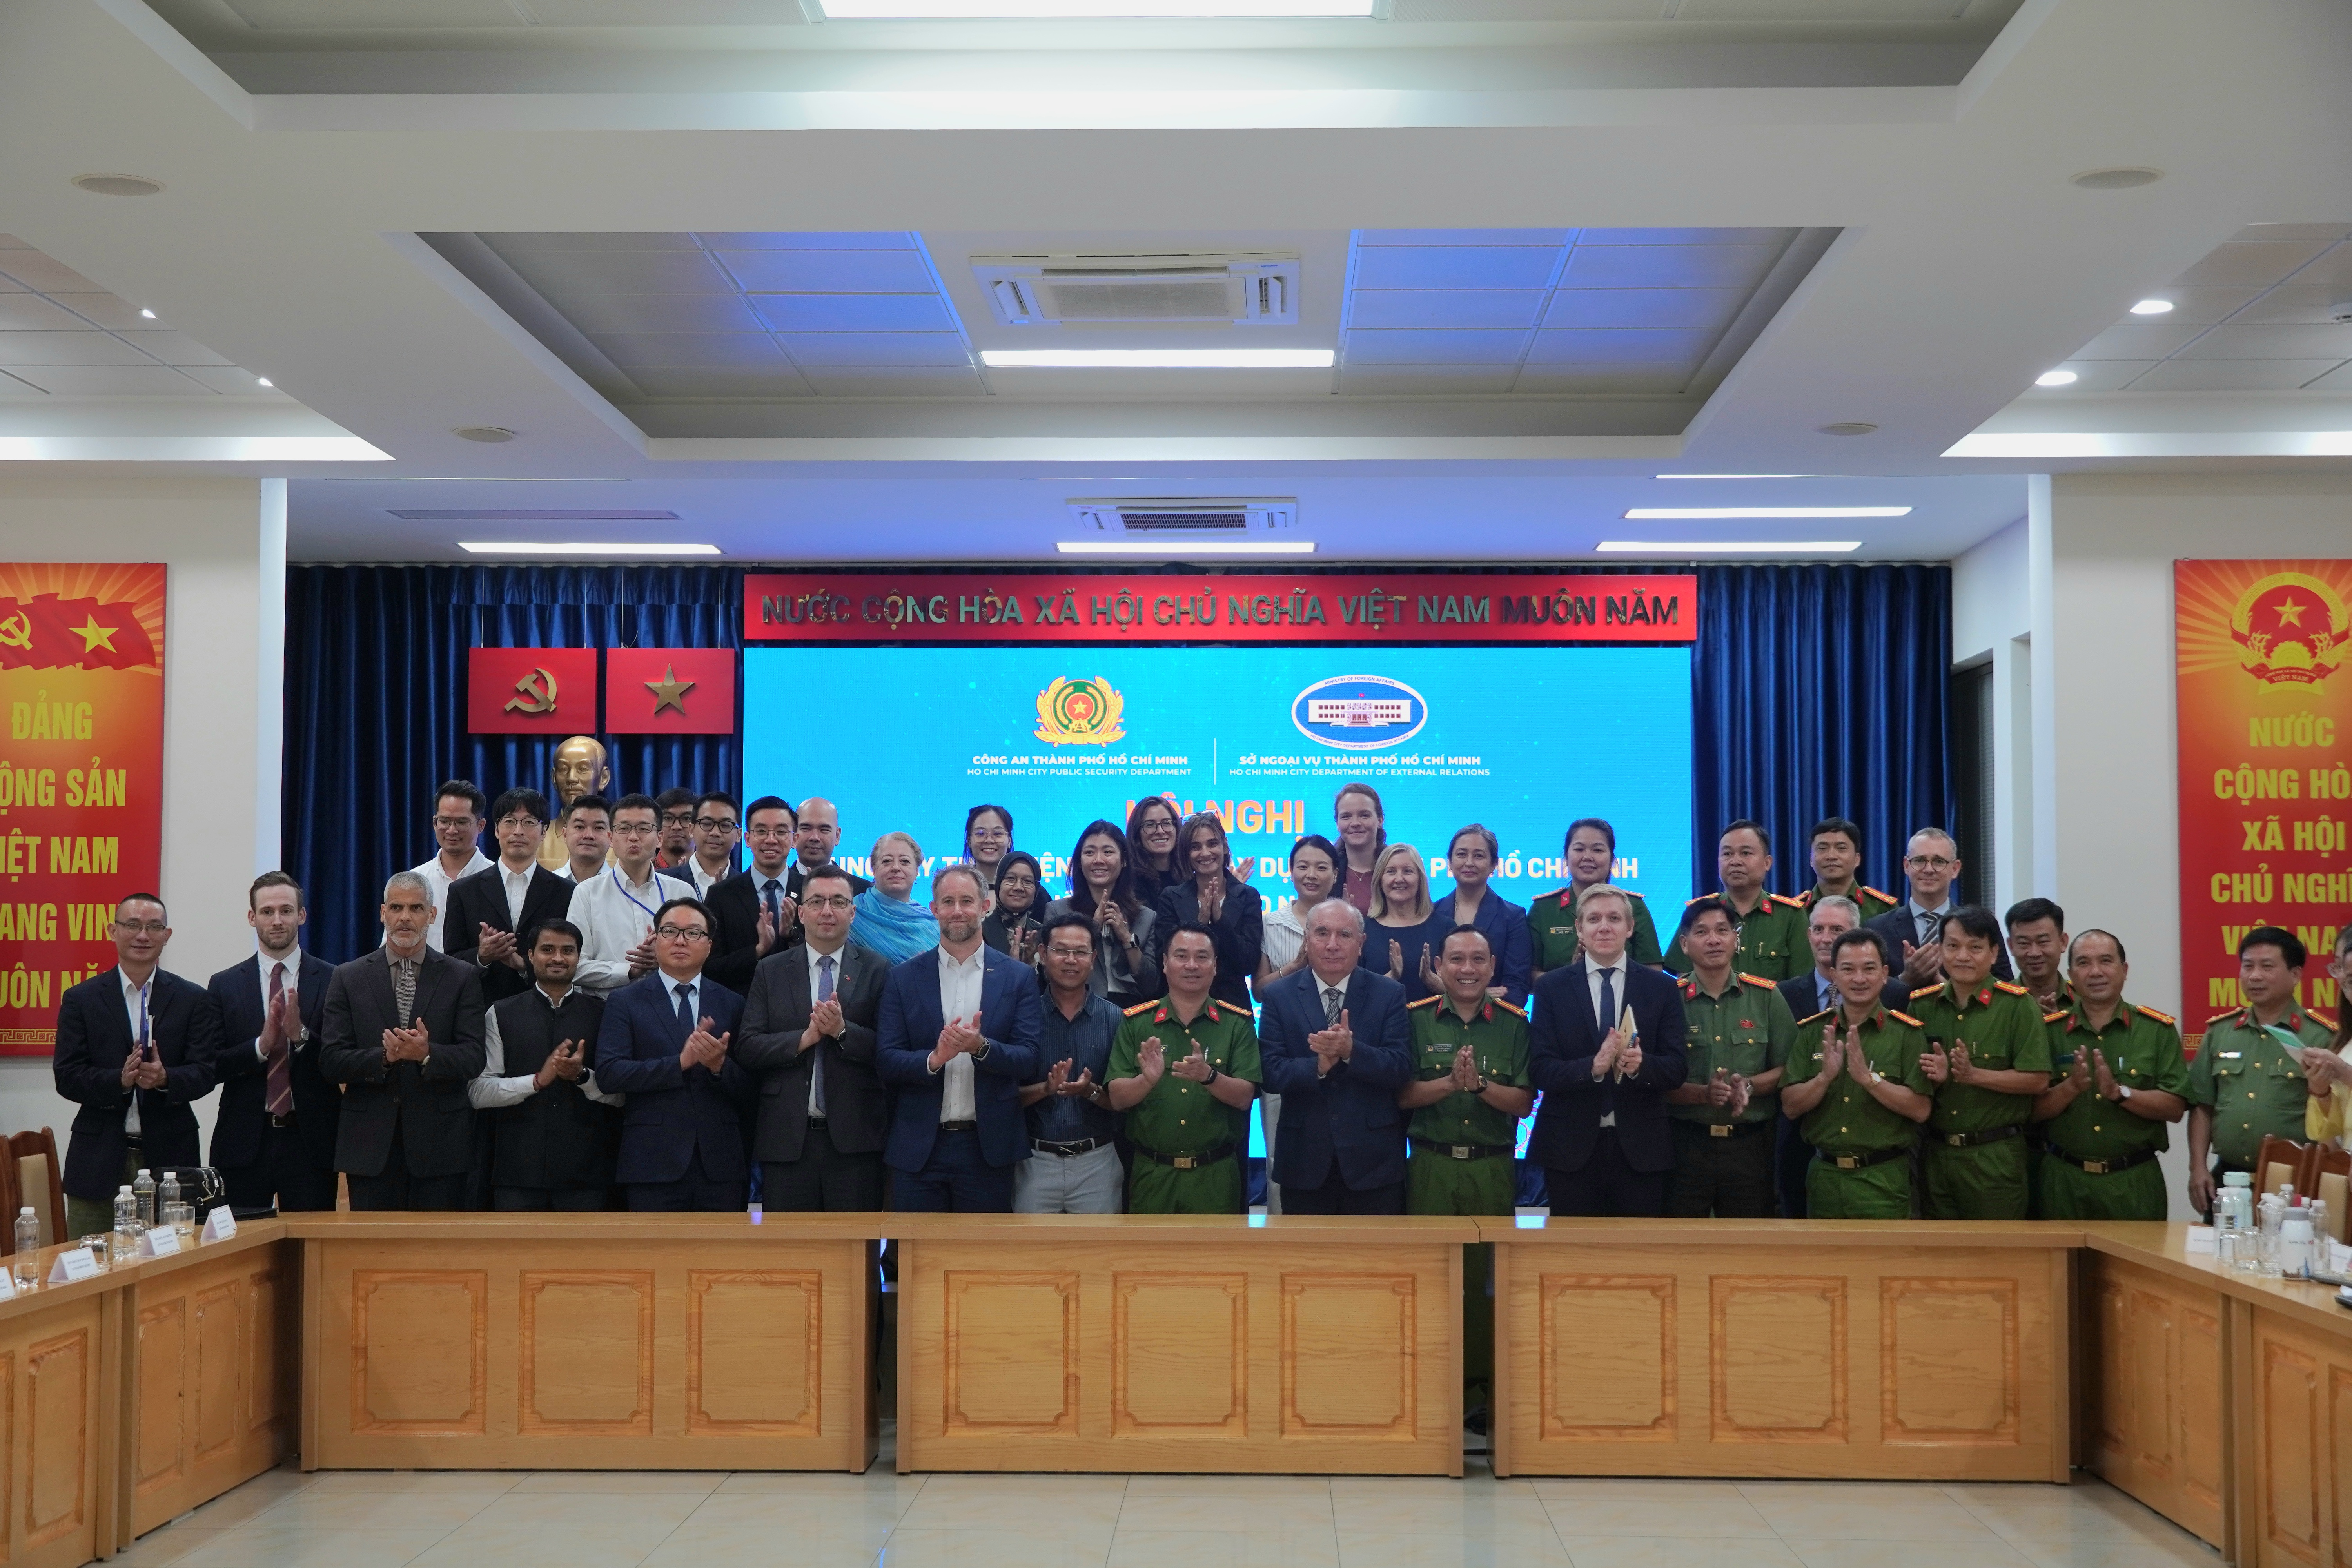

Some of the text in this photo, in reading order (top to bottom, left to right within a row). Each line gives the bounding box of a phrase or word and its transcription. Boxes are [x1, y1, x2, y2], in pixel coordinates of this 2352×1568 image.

[762, 586, 1678, 630] NƯỚC CỘNG HÒA XÃ HỘI CHỦ NGHĨA VIỆT NAM MUÔN NĂM
[12, 689, 93, 740] ĐẢNG
[2249, 711, 2334, 746] NƯỚC
[972, 753, 1187, 765] CÔNG AN THÀNH PHỐ HỒ CHÍ MINH
[1239, 753, 1481, 767] SỞ NGOẠI VỤ THÀNH PHỐ HỒ CHÍ MINH
[66, 757, 125, 807] SẢN
[2214, 762, 2352, 806] CỘNG HÒ
[50, 836, 118, 874] NAM
[2241, 815, 2346, 857] XÃ HỘI
[2211, 863, 2272, 903] CHỦ
[67, 904, 119, 940] VIN
